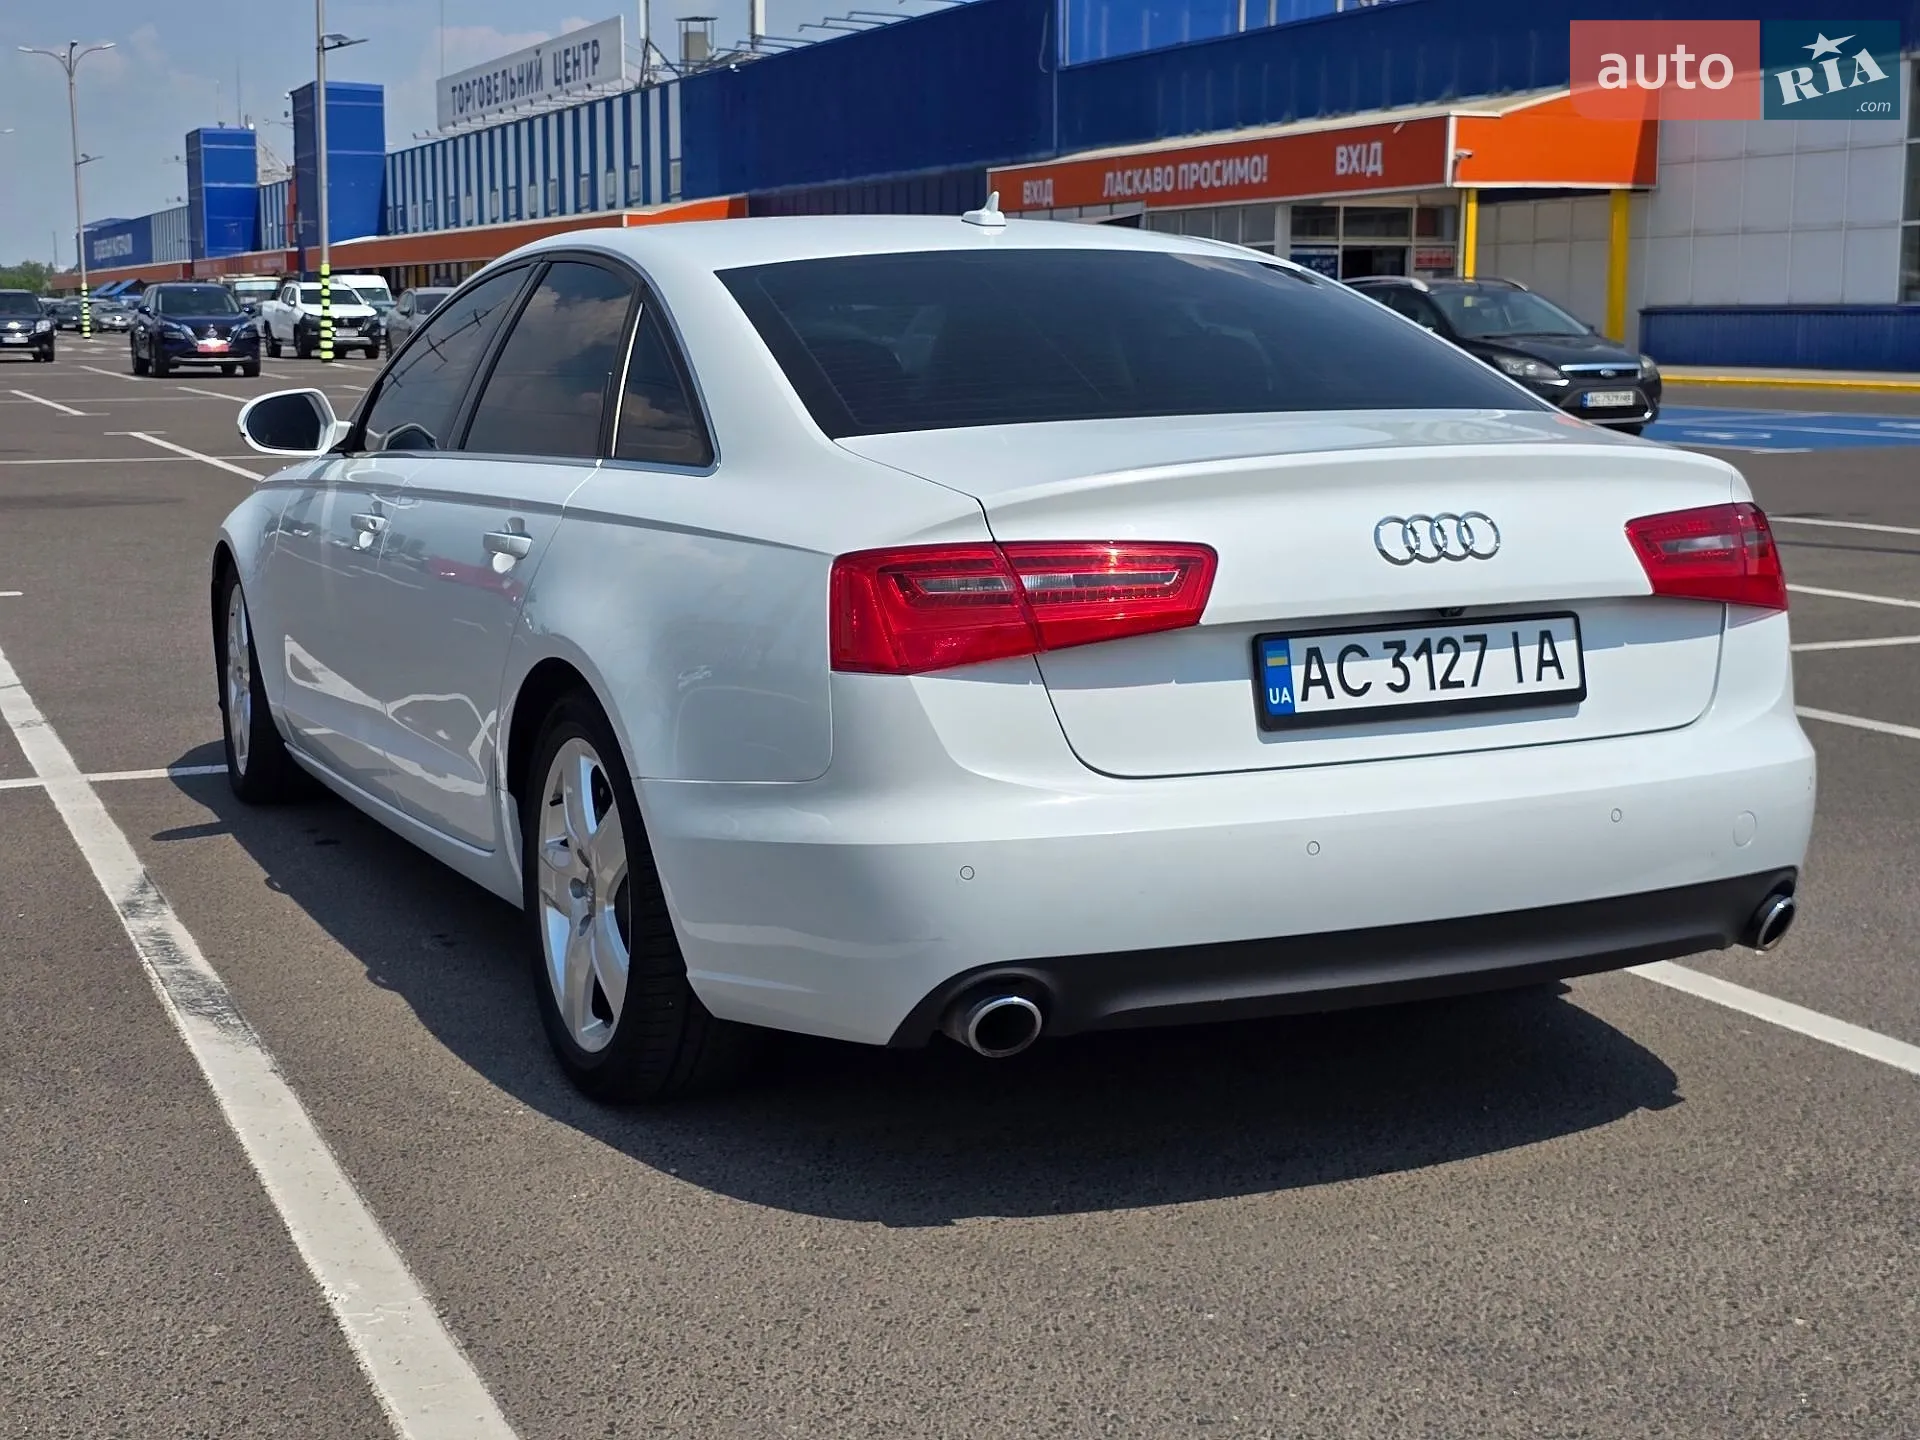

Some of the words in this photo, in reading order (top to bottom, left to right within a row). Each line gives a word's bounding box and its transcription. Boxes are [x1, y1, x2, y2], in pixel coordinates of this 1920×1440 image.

[451, 49, 543, 116] ТОРГОВЕЛЬНИЙ
[553, 39, 600, 91] ЦЕНТР
[1103, 165, 1173, 198] ЛАСКАВО
[1177, 154, 1269, 191] ПРОСИМО!
[1335, 141, 1383, 177] ВХІД
[1023, 179, 1054, 207] ВХІД
[1300, 643, 1373, 702] AC
[1382, 633, 1488, 693] 3127
[1511, 629, 1565, 683] IA
[1269, 687, 1293, 705] UA
